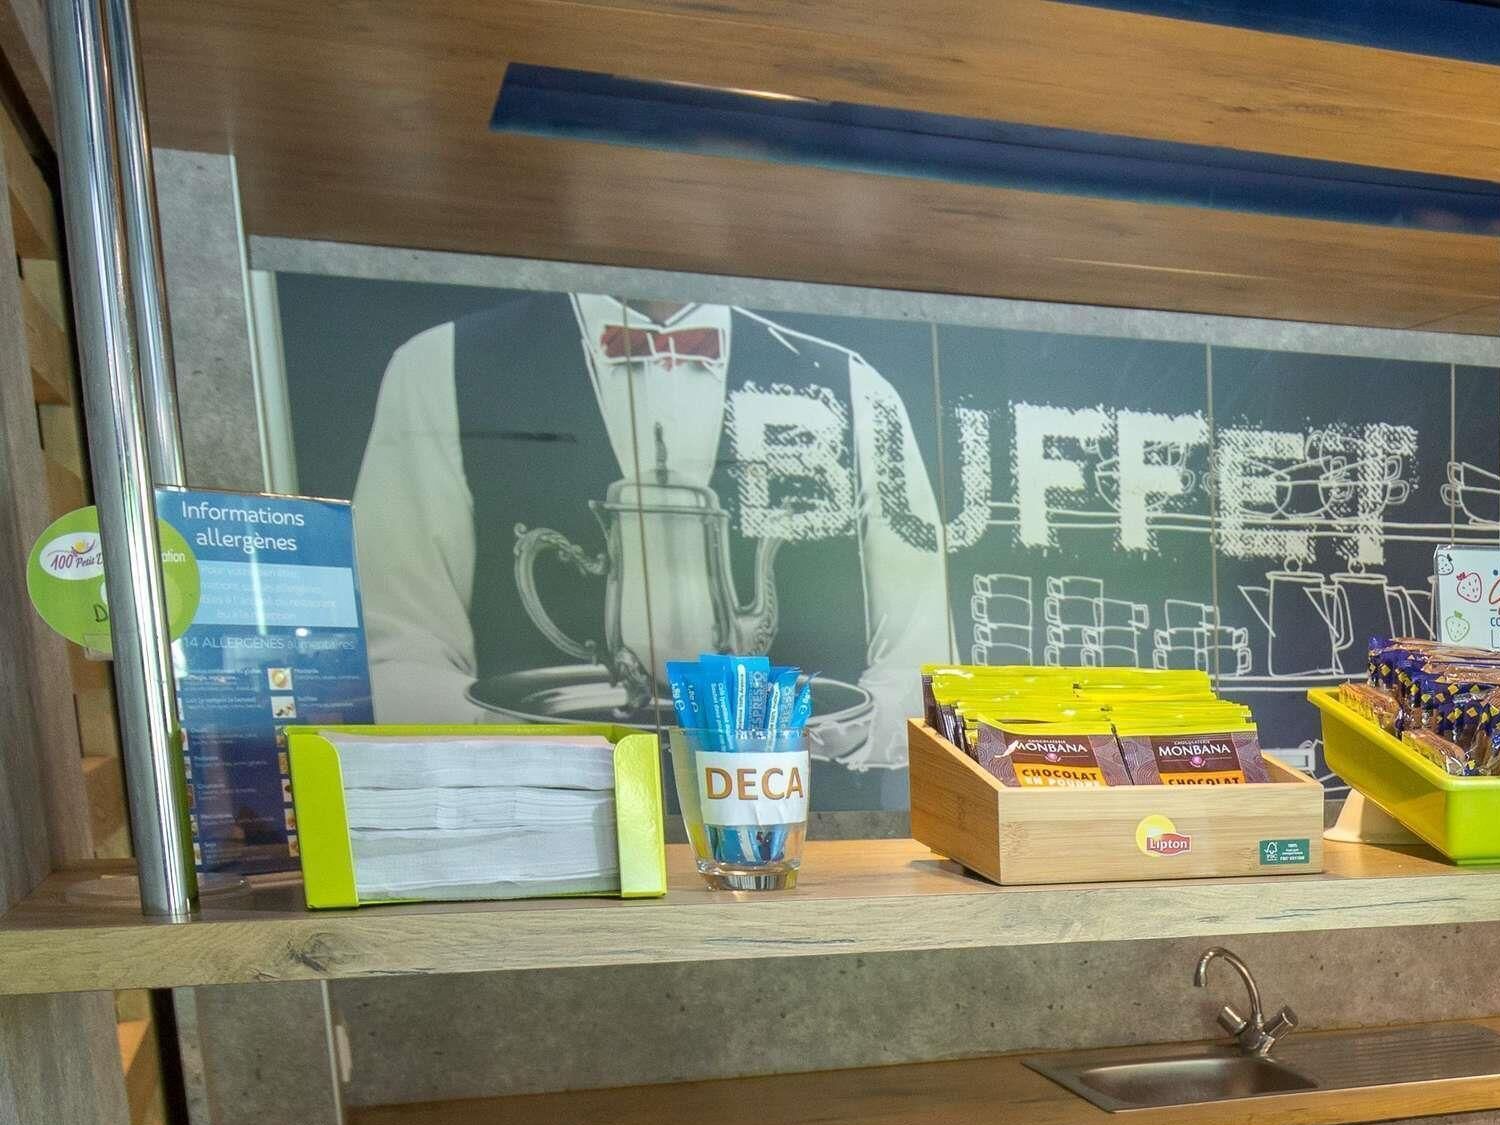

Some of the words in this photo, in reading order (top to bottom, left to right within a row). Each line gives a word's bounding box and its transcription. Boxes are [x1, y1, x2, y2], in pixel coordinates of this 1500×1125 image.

[727, 379, 1419, 566] BUFFET
[182, 501, 304, 526] Informations
[196, 527, 297, 554] allergènes
[50, 554, 73, 571] 100
[1015, 742, 1088, 753] MONBANA
[1158, 744, 1231, 757] MONBANA
[1022, 769, 1097, 780] CHOCOLAT
[705, 767, 804, 800] DECA
[1149, 839, 1188, 852] Lipton
